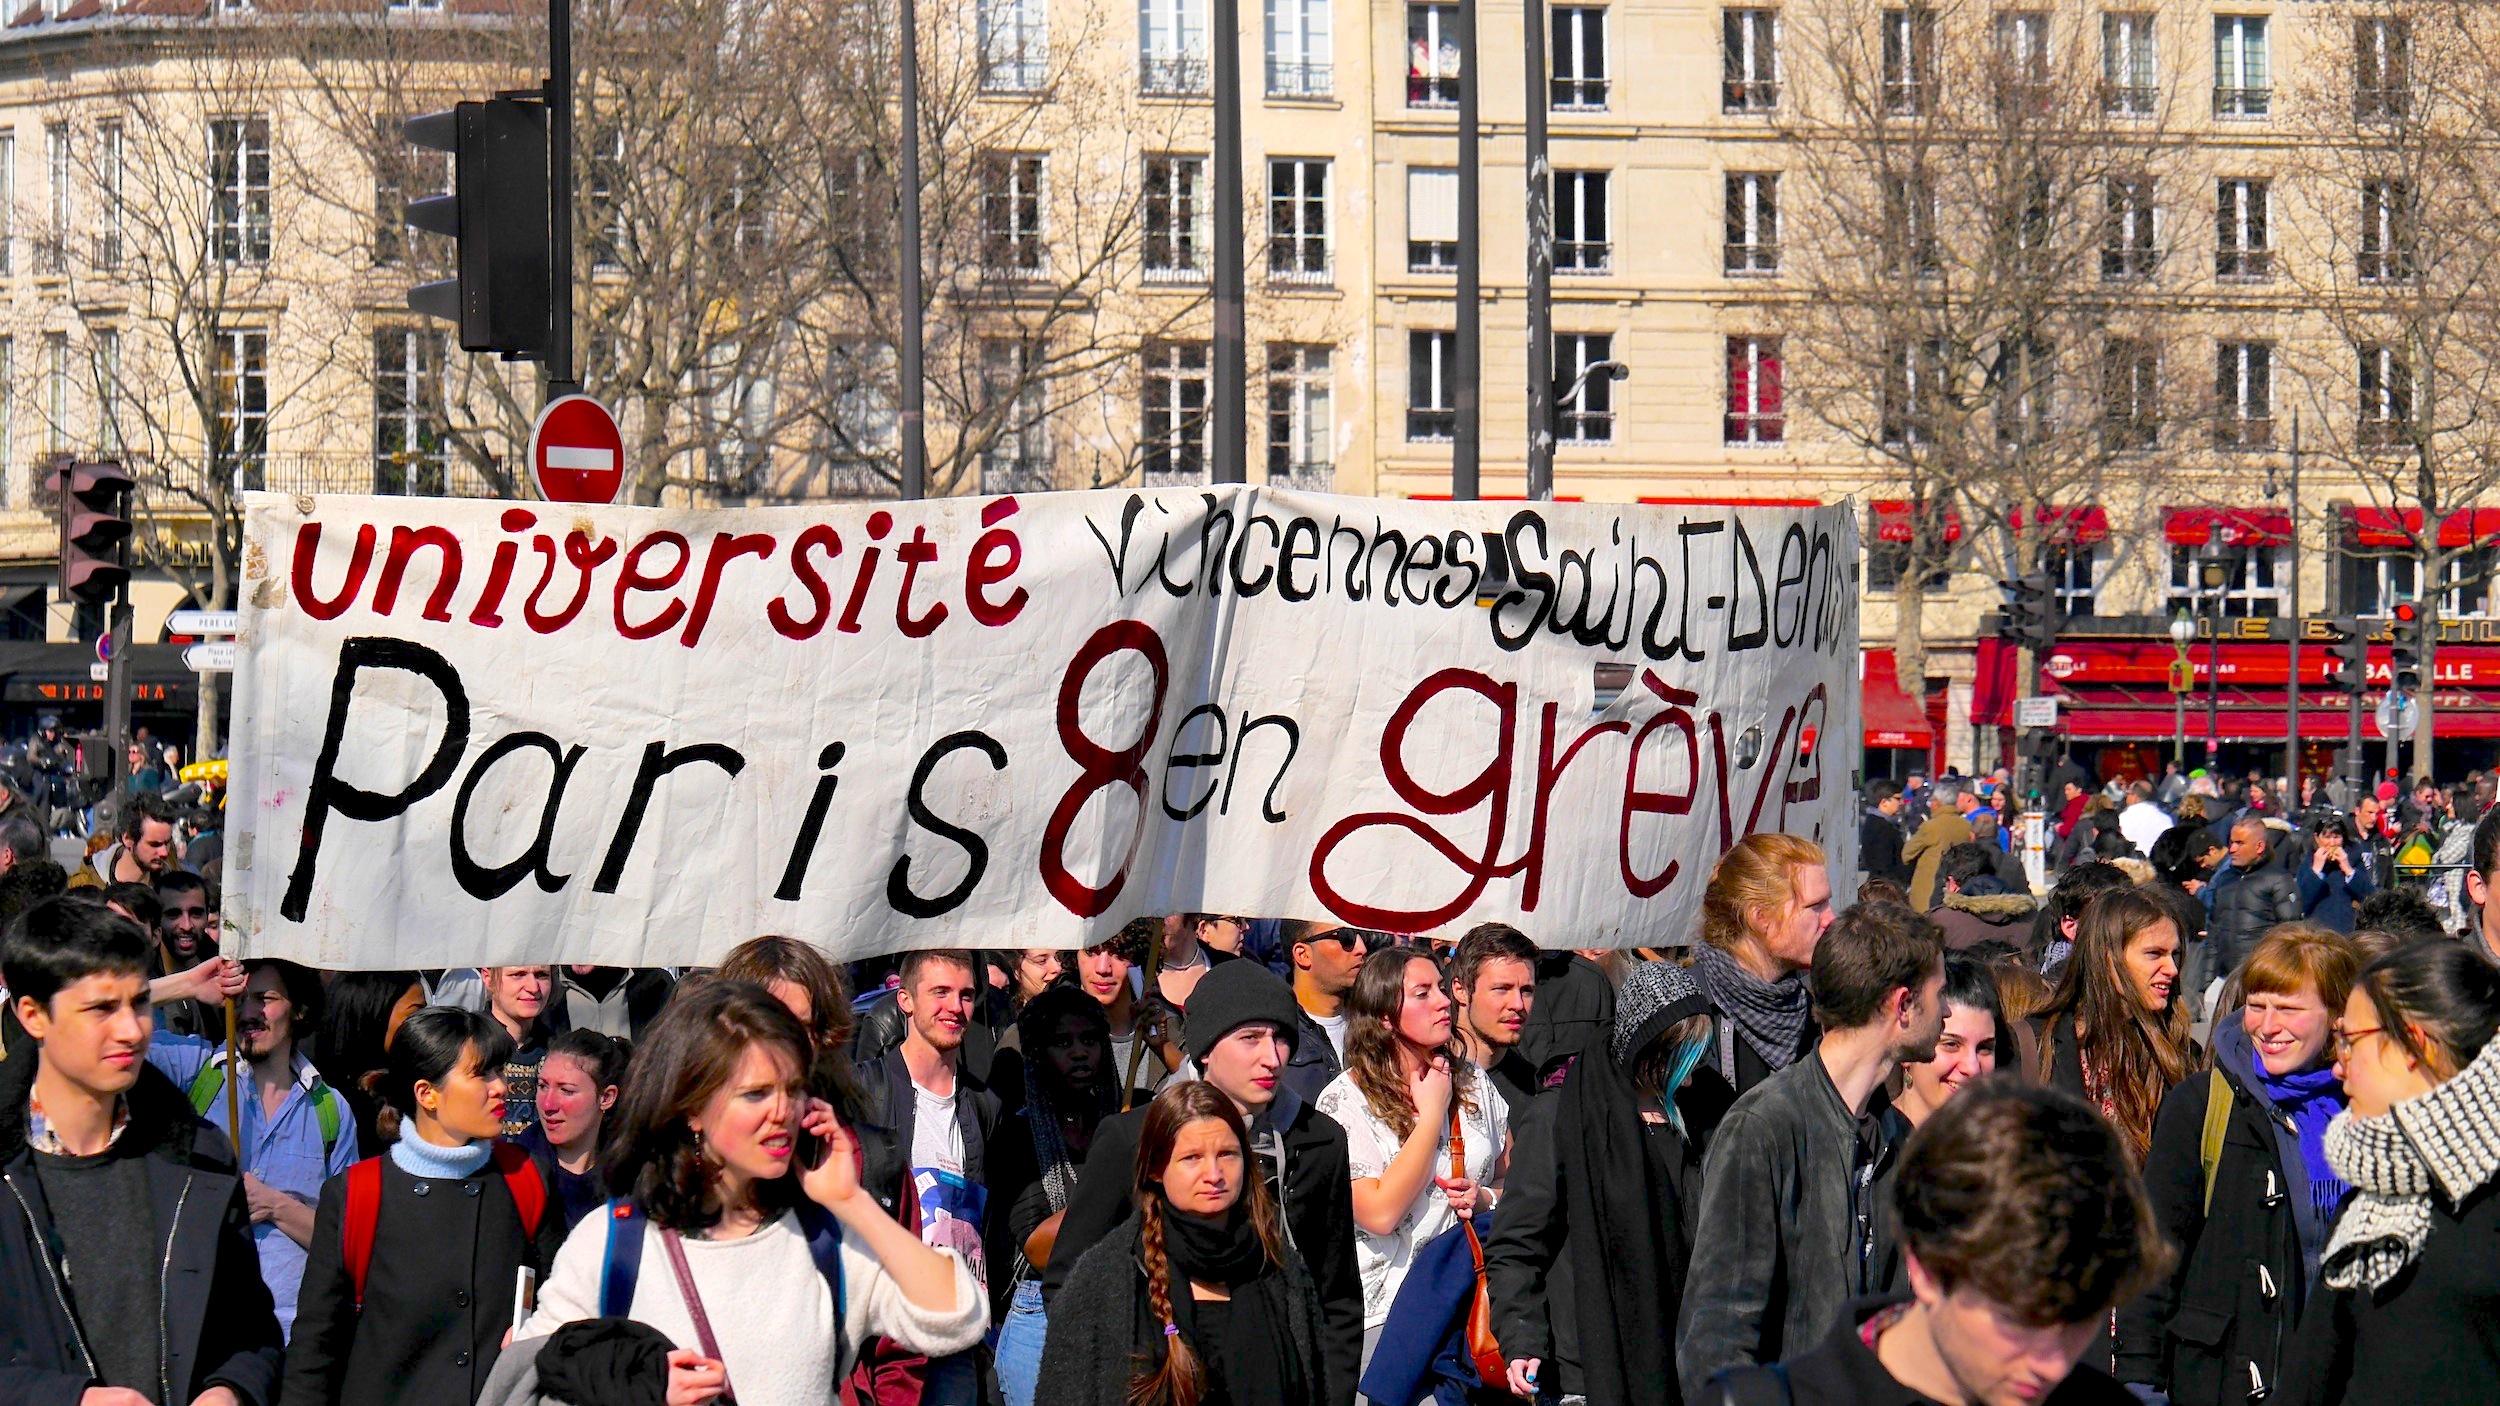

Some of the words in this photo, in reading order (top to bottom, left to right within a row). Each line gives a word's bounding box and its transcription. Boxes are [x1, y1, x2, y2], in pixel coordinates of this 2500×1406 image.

[291, 496, 1029, 648] université
[1085, 494, 1480, 609] Vincennes
[281, 636, 1008, 923] Paris
[1039, 619, 1169, 918] 8
[1161, 703, 1300, 823] en
